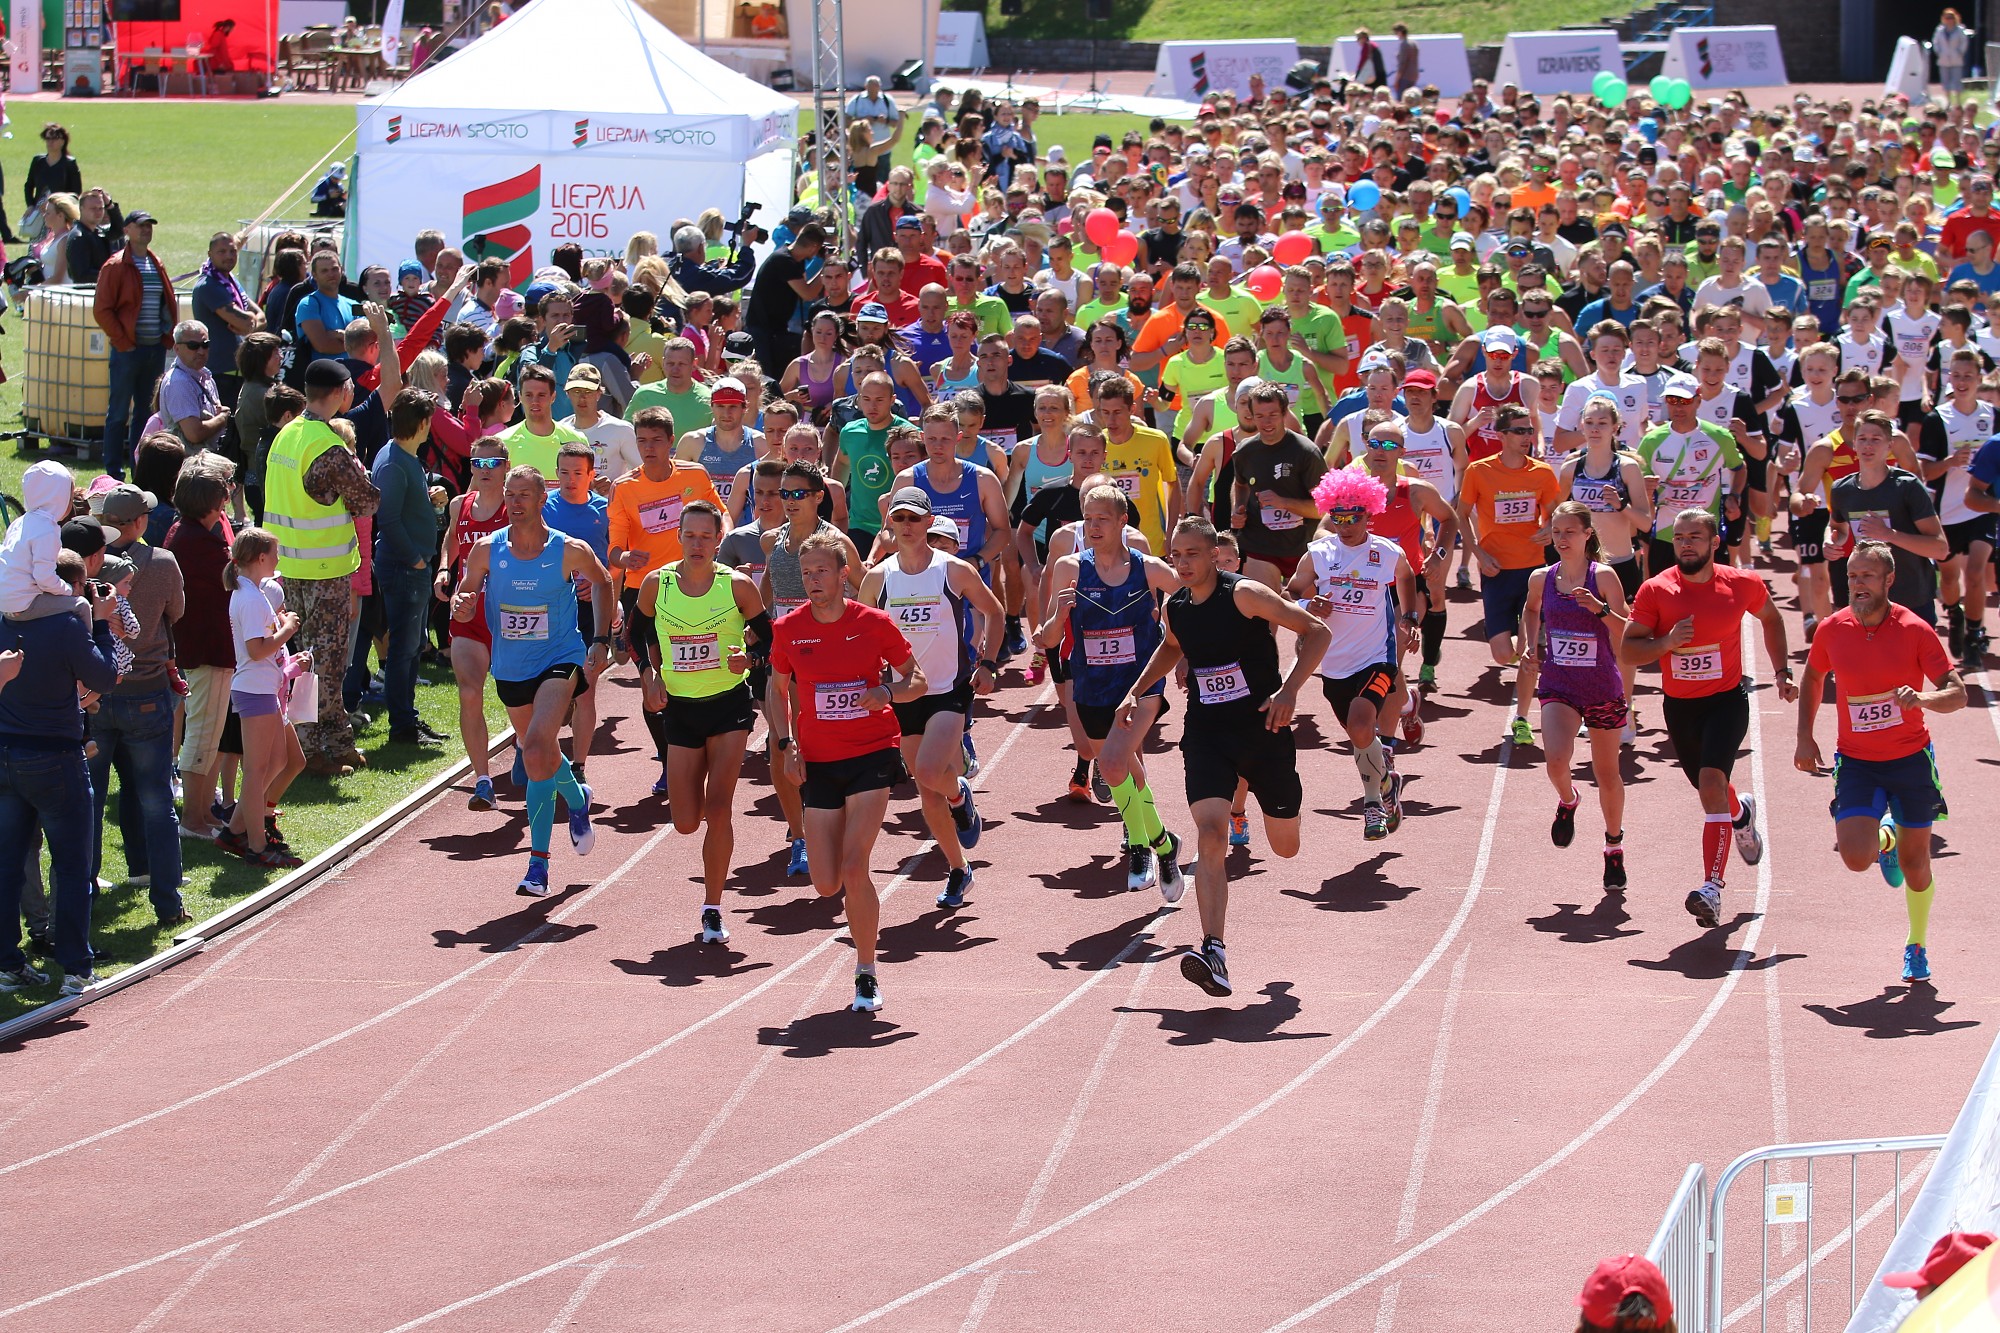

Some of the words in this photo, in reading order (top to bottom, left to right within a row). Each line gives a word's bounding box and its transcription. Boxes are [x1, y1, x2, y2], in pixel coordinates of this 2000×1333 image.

[1537, 55, 1600, 74] IZRAVIENS
[467, 123, 529, 139] SPORTO
[654, 129, 716, 146] SPORTO
[551, 212, 608, 238] 2016
[1902, 342, 1923, 351] 806
[1416, 458, 1433, 471] 74
[1671, 489, 1700, 500] 127
[658, 508, 668, 522] 4
[1273, 509, 1292, 522] 94
[1502, 501, 1529, 515] 353
[1800, 543, 1818, 557] 10
[1341, 589, 1364, 604] 49
[900, 607, 932, 622] 455
[507, 615, 540, 630] 337
[705, 617, 727, 632] SUUNTO
[679, 645, 710, 661] 119
[1099, 639, 1120, 655] 13
[1557, 640, 1589, 657] 759
[1680, 655, 1712, 671] 395
[1205, 675, 1236, 692] 689
[825, 692, 860, 710] 598
[1858, 703, 1892, 722] 458
